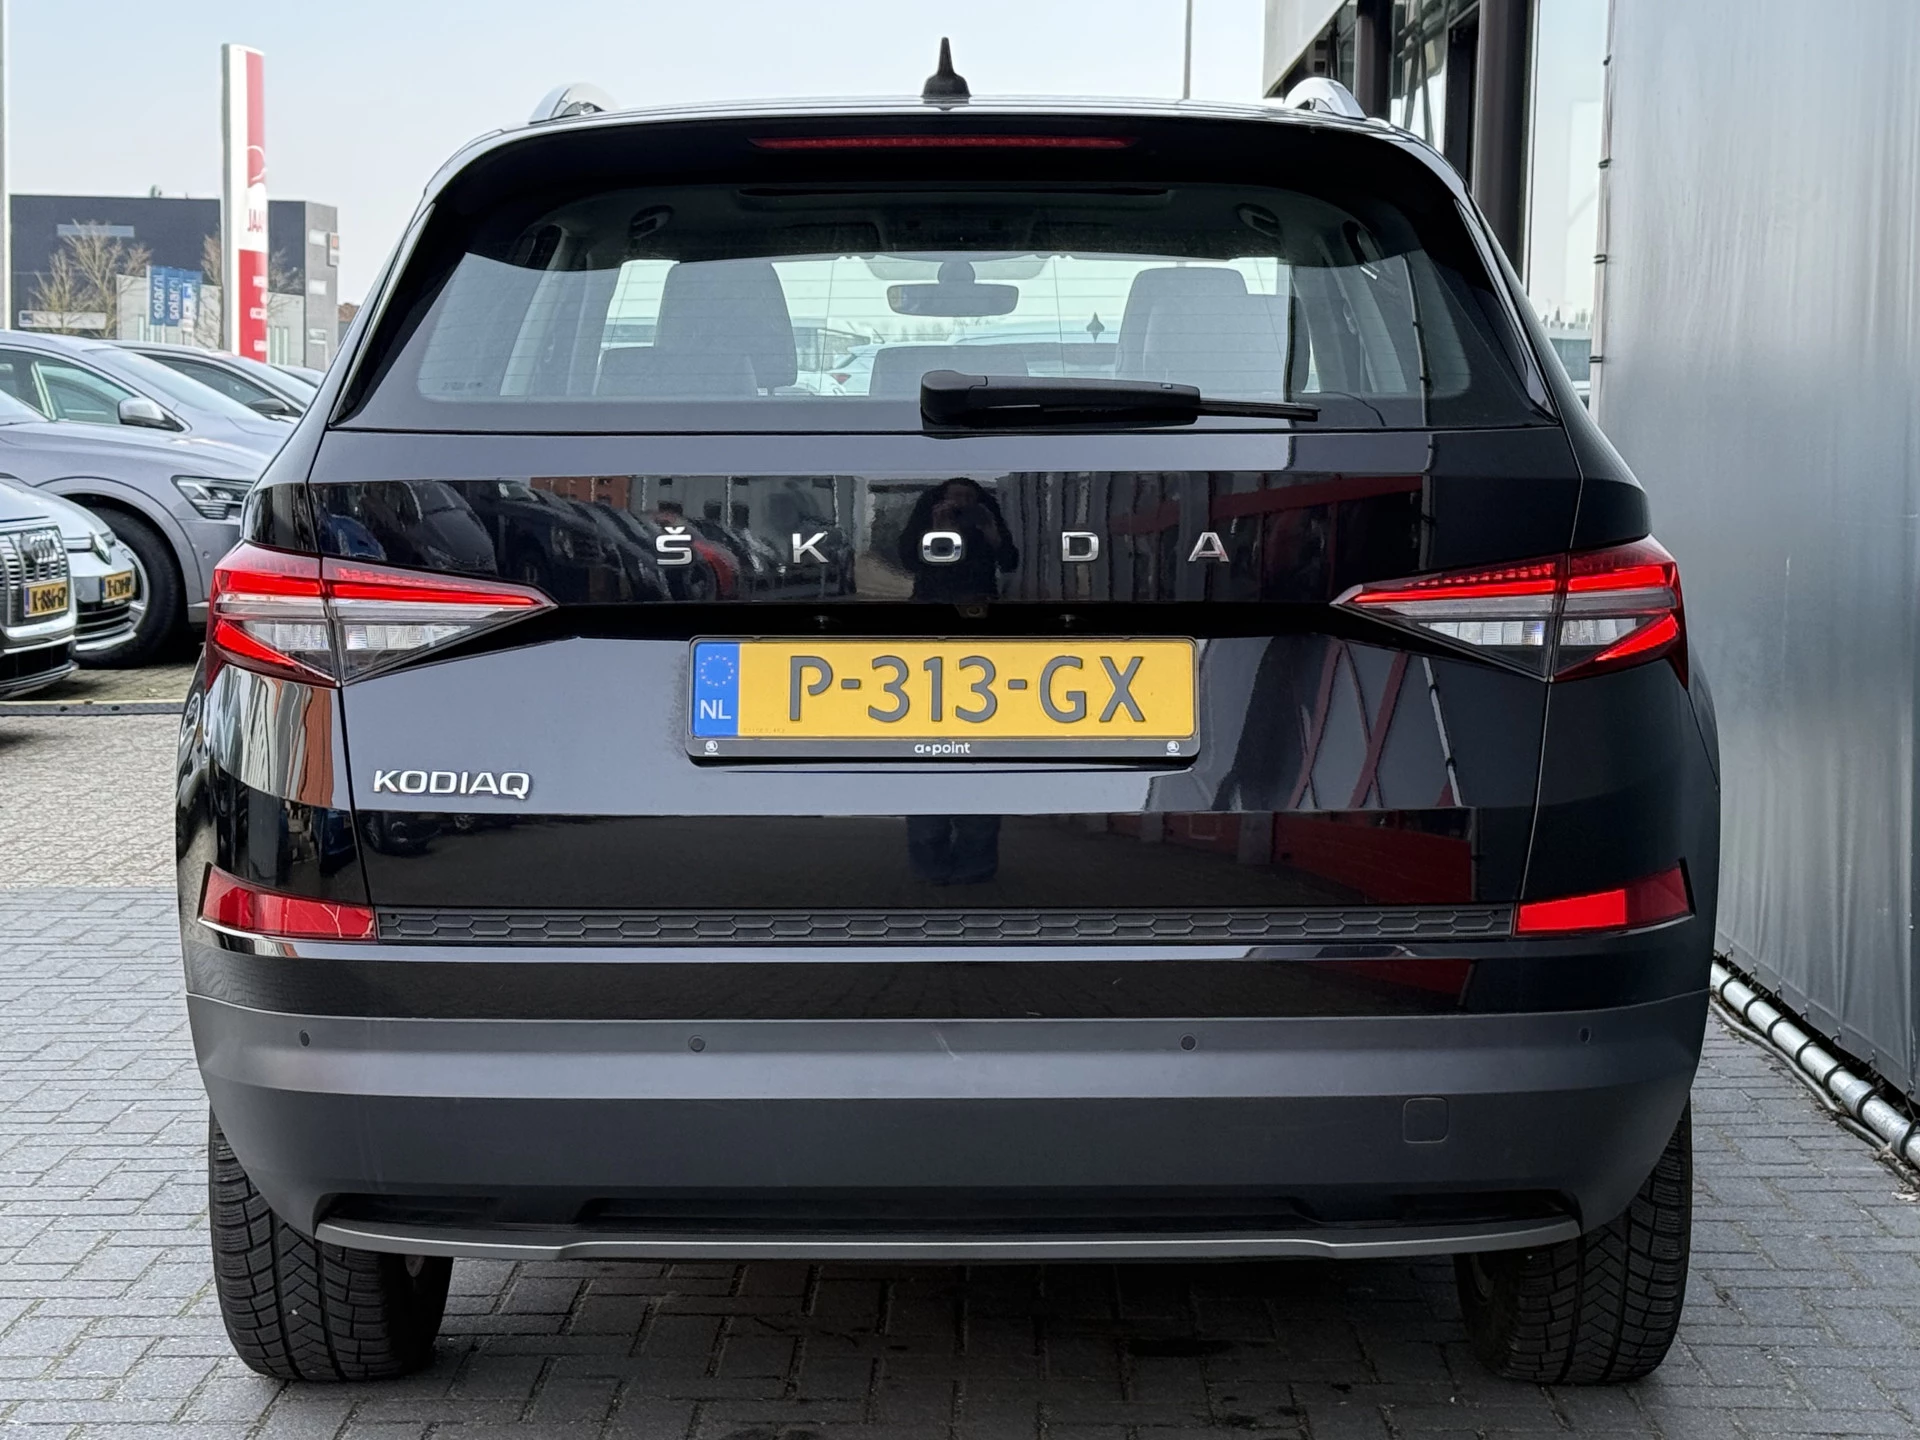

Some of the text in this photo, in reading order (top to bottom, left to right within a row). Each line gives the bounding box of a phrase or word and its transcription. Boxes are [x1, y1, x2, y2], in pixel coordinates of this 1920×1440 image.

[656, 526, 1230, 566] ŠKODA
[789, 655, 1146, 723] P-313-GX
[700, 699, 732, 720] NL
[373, 769, 530, 800] KODIAQ
